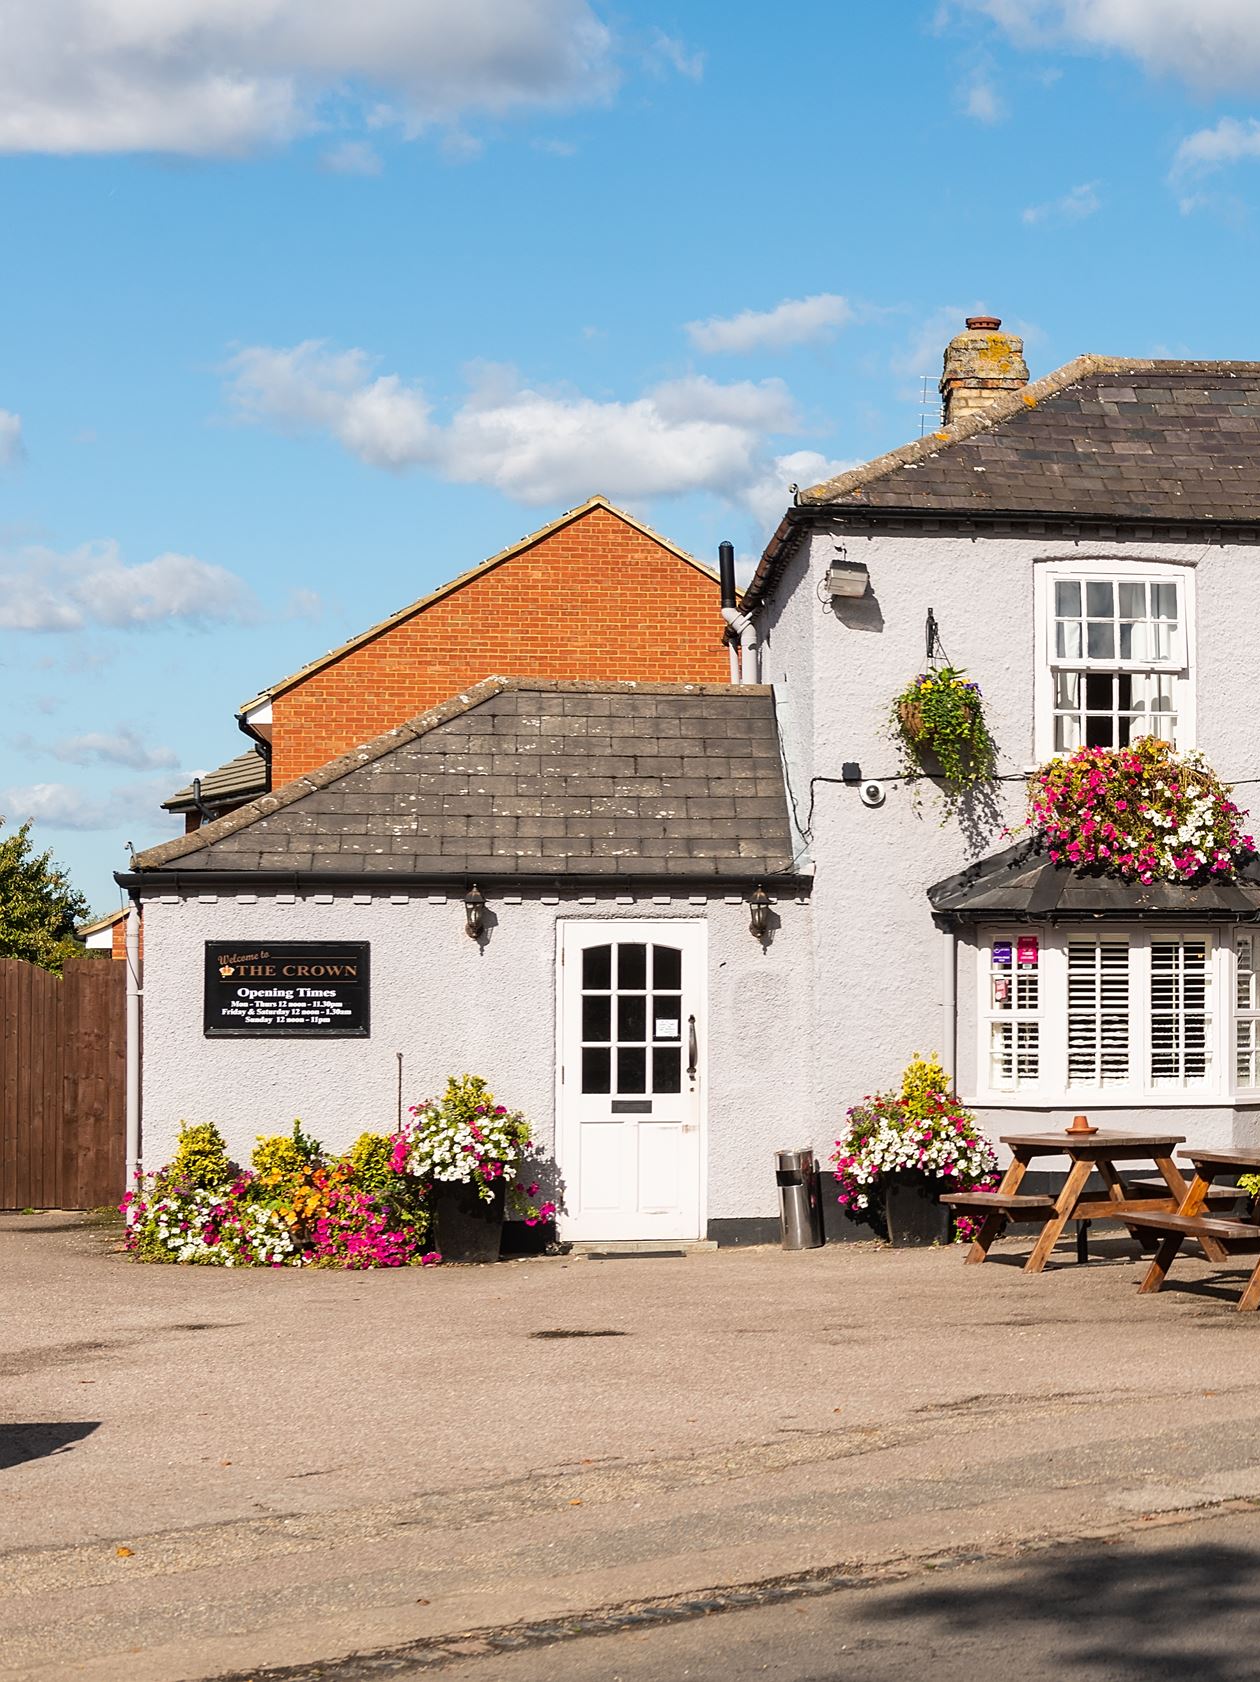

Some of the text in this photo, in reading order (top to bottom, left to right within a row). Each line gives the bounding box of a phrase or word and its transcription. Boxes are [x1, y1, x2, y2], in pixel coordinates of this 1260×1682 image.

[217, 950, 271, 965] Welcome to
[235, 965, 358, 977] THE CROWN
[237, 987, 337, 1000] Opening Times
[230, 1000, 249, 1008] Mon
[254, 1000, 277, 1008] Thurs
[278, 1000, 288, 1008] 12
[312, 1000, 343, 1009] 11.30pm
[221, 1008, 247, 1017] Friday
[256, 1008, 291, 1017] Saturday
[244, 1016, 274, 1025] Sunday
[310, 1016, 331, 1025] 11pm
